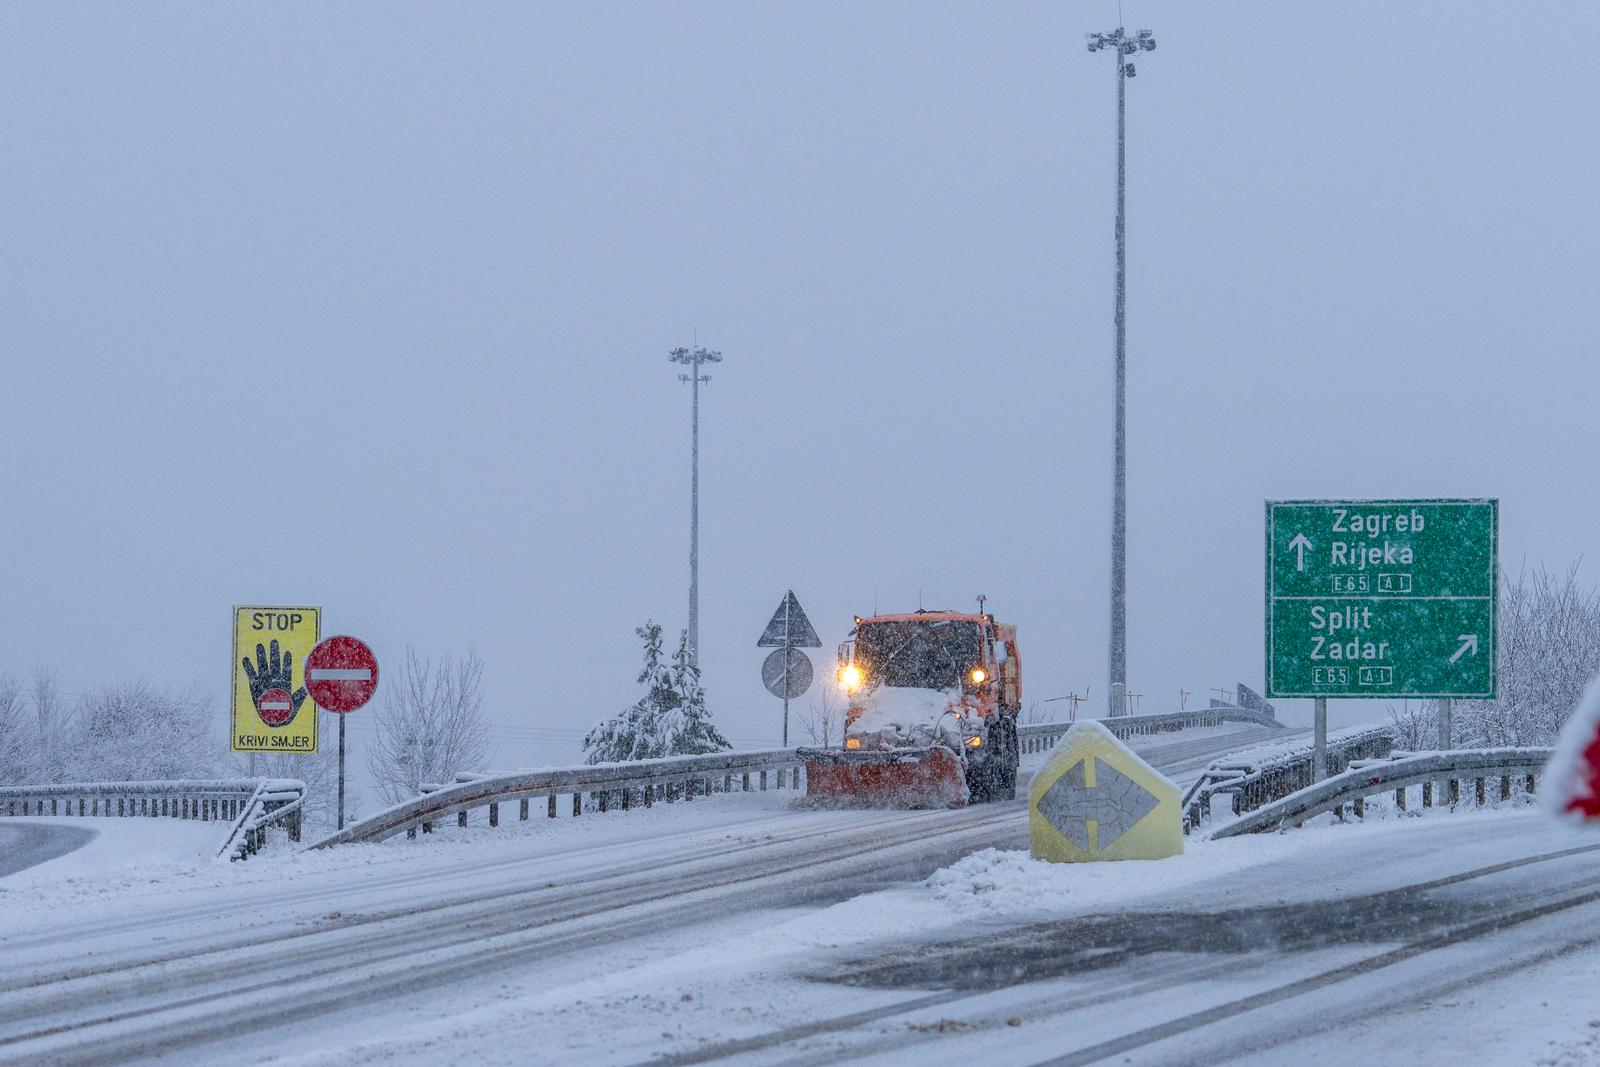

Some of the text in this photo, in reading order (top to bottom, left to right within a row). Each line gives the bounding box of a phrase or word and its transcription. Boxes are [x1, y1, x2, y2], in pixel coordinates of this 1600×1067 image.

[1331, 509, 1425, 538] Zagreb
[1331, 541, 1414, 571] Rijeka
[252, 613, 303, 631] STOP
[1310, 605, 1372, 635] Split
[1310, 637, 1390, 661] Zadar
[238, 735, 310, 748] KRIVI SMJER
